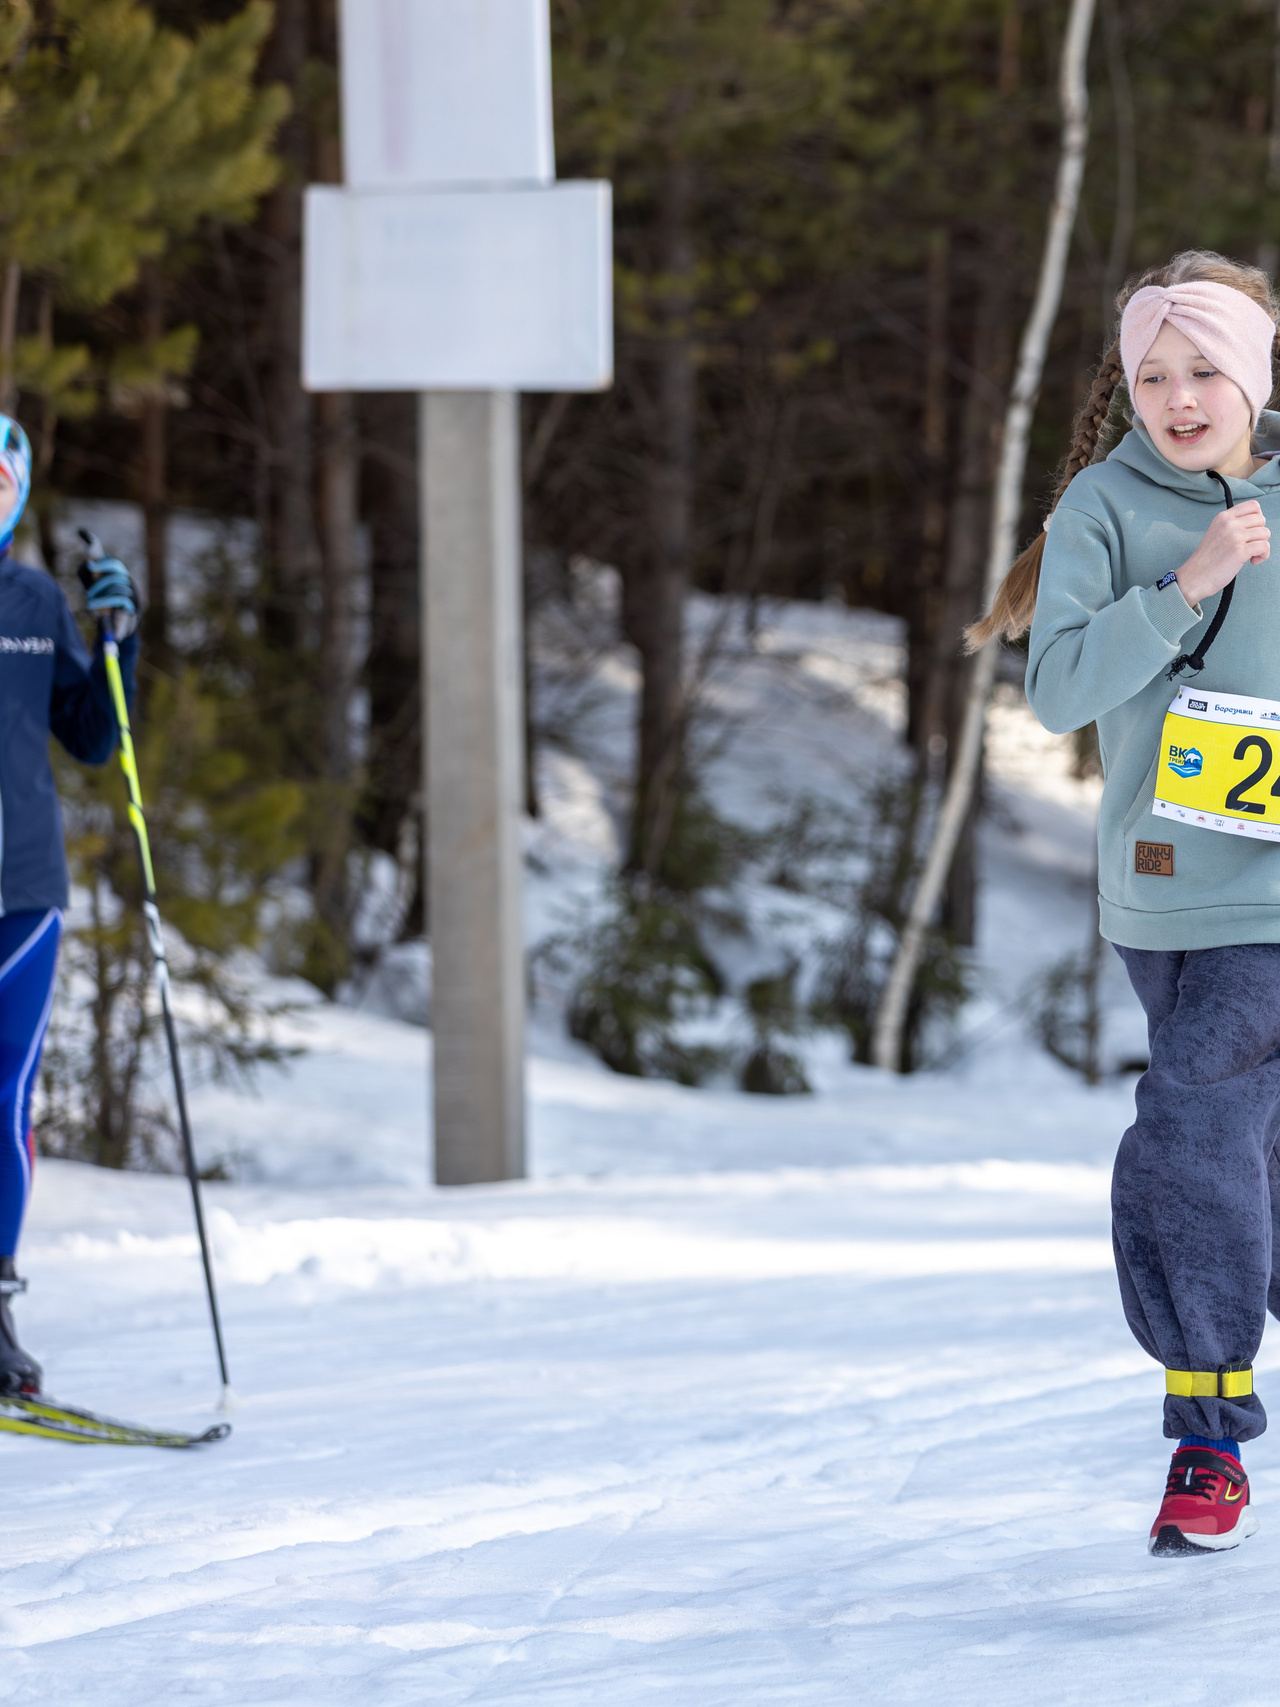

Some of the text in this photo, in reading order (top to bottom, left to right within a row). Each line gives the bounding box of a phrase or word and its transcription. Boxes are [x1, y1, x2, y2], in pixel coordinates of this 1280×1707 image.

[1214, 704, 1253, 716] Березники
[1138, 845, 1171, 860] FUNKY
[1224, 1465, 1242, 1481] FILA
